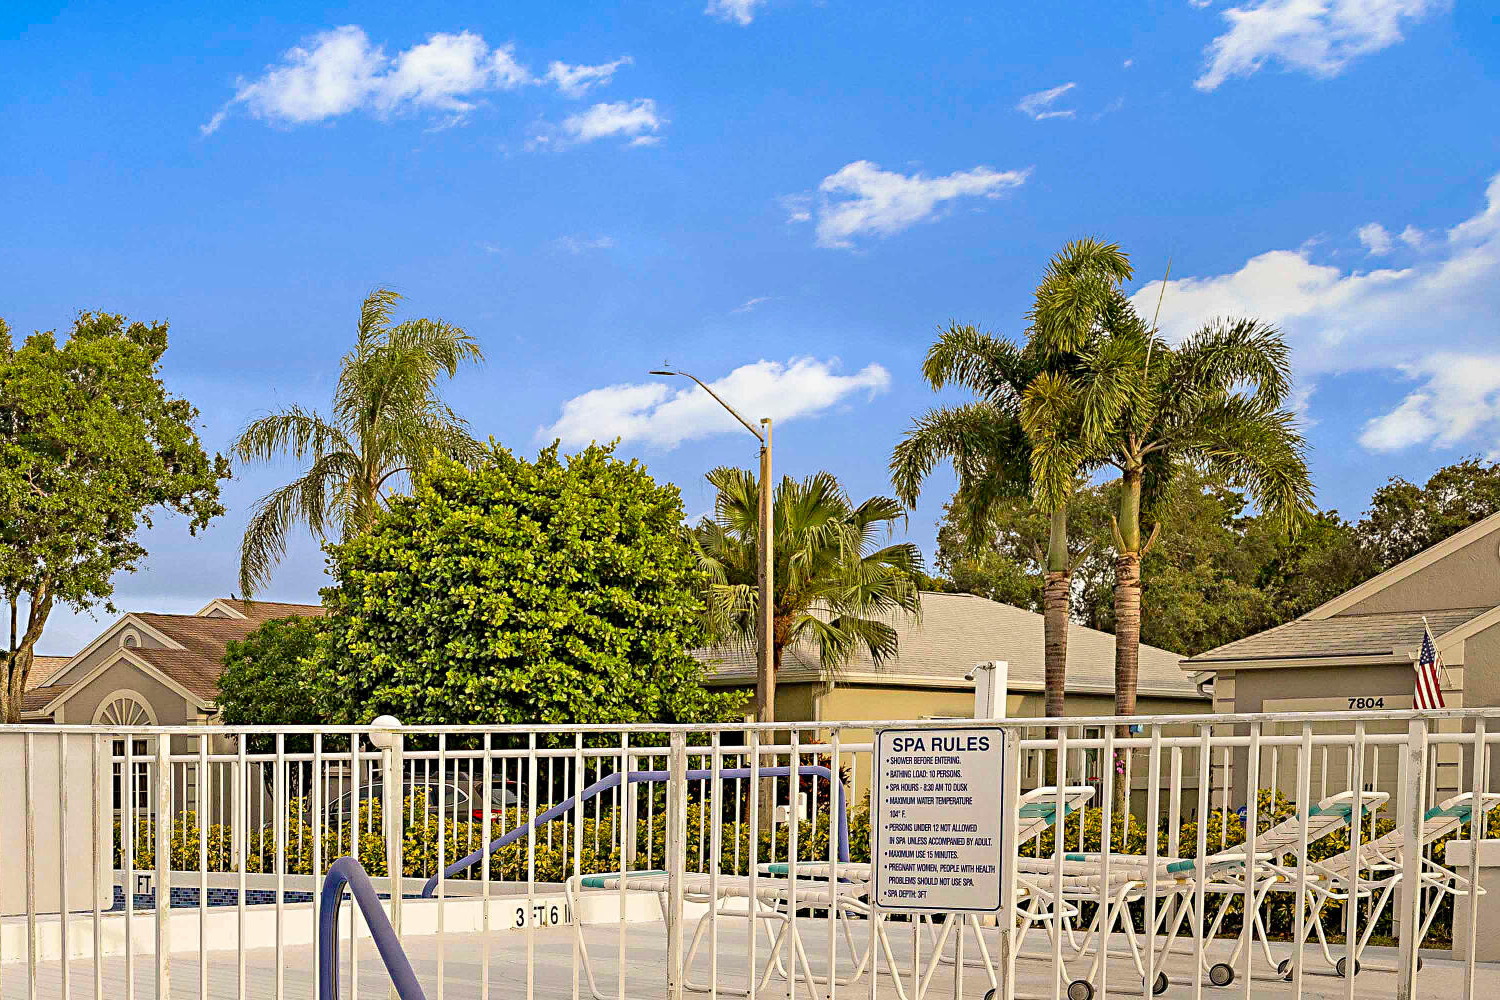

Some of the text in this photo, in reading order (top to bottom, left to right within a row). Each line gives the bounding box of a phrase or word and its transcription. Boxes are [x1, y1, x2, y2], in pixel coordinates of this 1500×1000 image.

[1348, 697, 1384, 709] 7804
[892, 736, 990, 752] SPA RULES
[890, 756, 962, 765] SHOWER BEFORE ENTERING.
[890, 769, 963, 778] BATHING LOAD: 10 PERSONS.
[889, 783, 900, 792] SPA
[900, 783, 919, 792] HOURS
[923, 783, 934, 792] 8:30
[935, 783, 944, 792] AM
[945, 783, 952, 792] TO
[953, 783, 968, 792] DUSK
[889, 796, 973, 805] MAXIMUM WATER TEMPERATURE
[901, 810, 907, 818] F.
[889, 824, 978, 833] PERSONS UNDER 12 NOT ALLOWED
[889, 836, 993, 847] IN SPA UNLESS ACCOMPANIED BY ADULT.
[888, 850, 959, 859] MAXIMUM USE 15 MINUTES.
[888, 863, 996, 874] PREGNANT WOMEN, PEOPLE WITH HEALTH
[137, 875, 152, 893] FT
[888, 876, 974, 887] PROBLEMS SHOULD NOT USE SPA.
[887, 889, 927, 899] SPA DEPTH: 3FT
[516, 907, 525, 927] 3
[550, 905, 559, 925] 6
